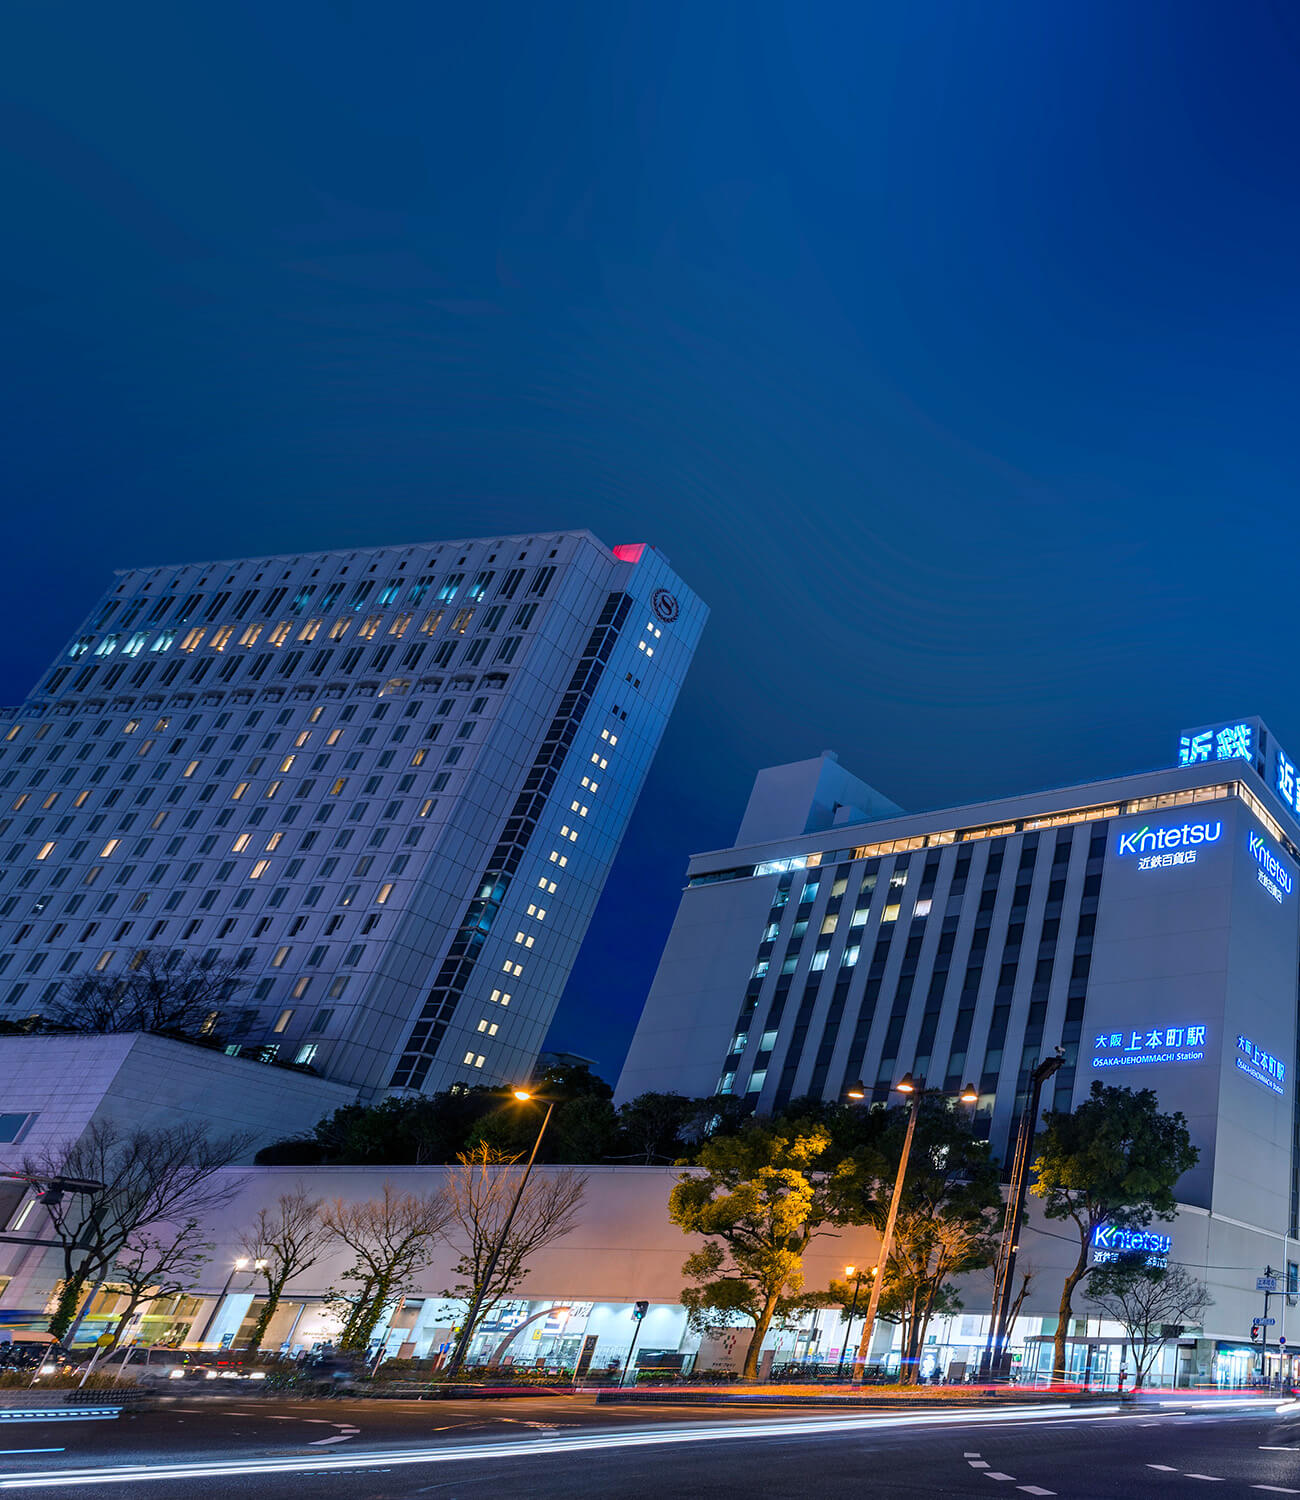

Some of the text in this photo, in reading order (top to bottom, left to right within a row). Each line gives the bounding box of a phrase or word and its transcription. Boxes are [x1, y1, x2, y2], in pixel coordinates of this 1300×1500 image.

[1178, 724, 1252, 768] 近鉄
[1119, 821, 1222, 854] Kintetsu
[1138, 850, 1196, 870] 近鉄百貨店
[1249, 831, 1292, 893] Kintetsu
[1177, 1051, 1203, 1061] Station
